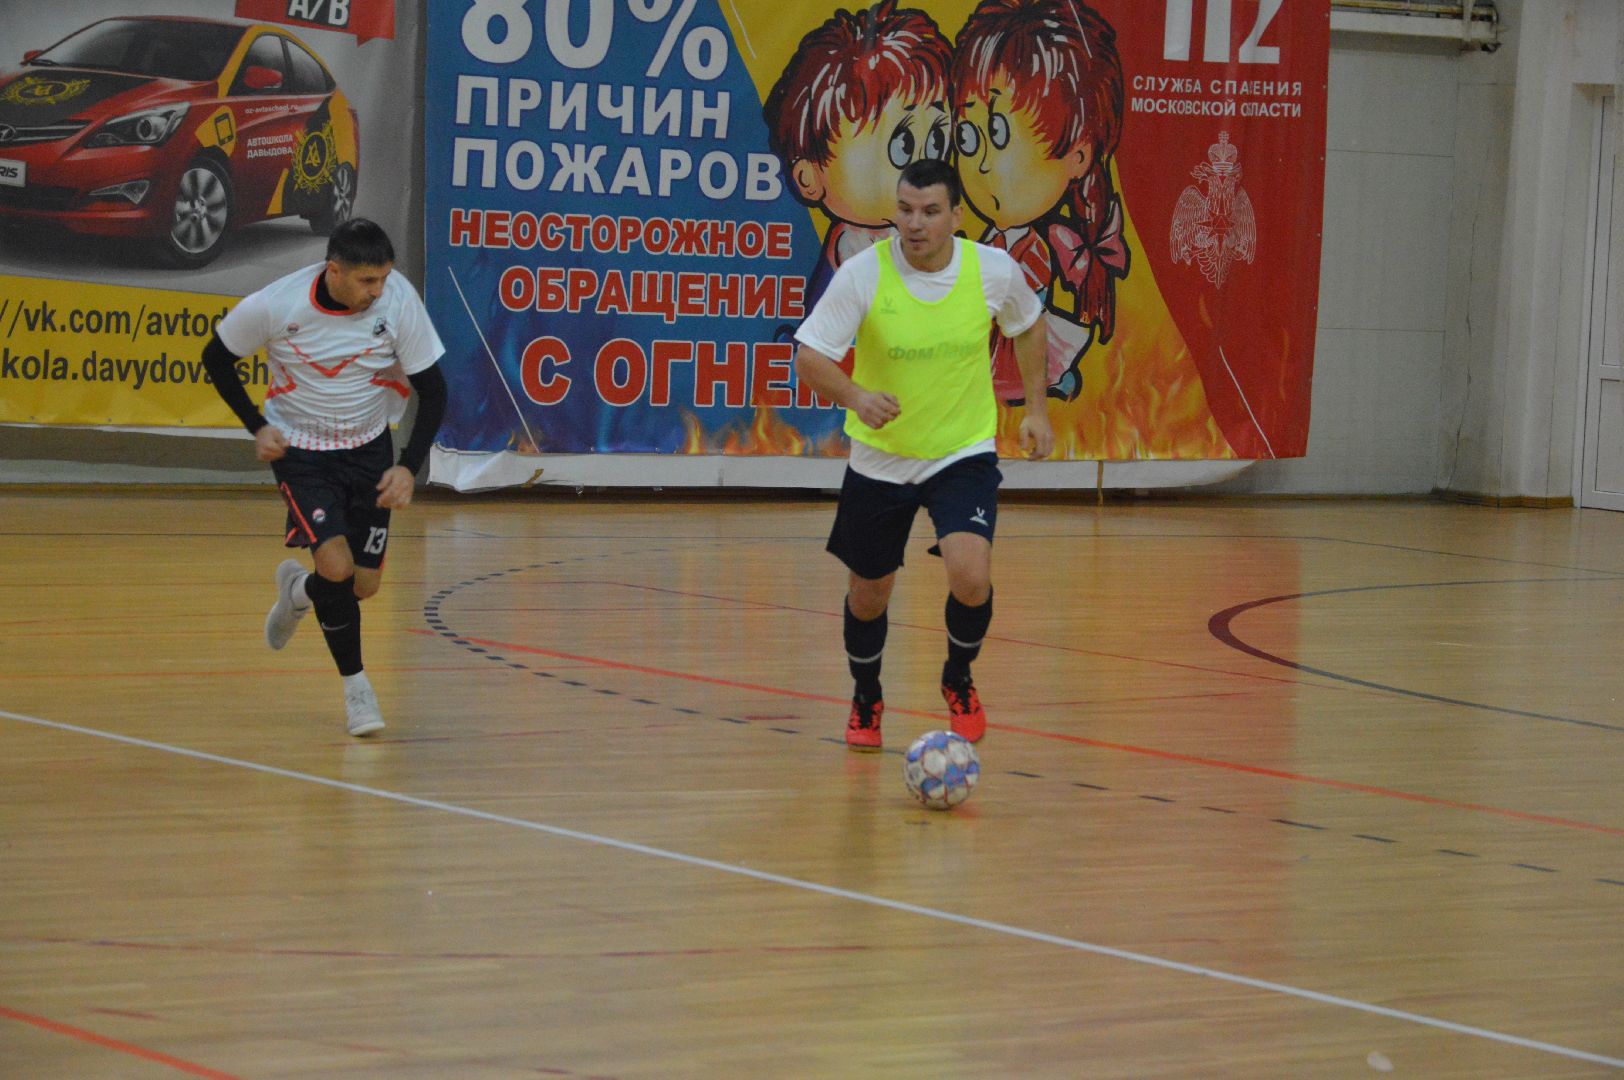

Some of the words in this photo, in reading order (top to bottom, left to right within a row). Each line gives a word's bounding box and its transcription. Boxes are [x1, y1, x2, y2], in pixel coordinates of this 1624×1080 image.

[461, 0, 729, 80] 80%
[455, 74, 731, 139] ПРИЧИН
[1131, 97, 1236, 117] МОСКОВСКОЙ
[1132, 75, 1202, 93] СЛУЖБА
[1210, 80, 1302, 96] СПАЕНИЯ
[247, 134, 293, 147] АВТОШКОЛА
[247, 146, 293, 159] ДАВЫДОВА
[451, 137, 784, 201] ПОЖАРОВ
[449, 208, 793, 258] НЕОСТОРОЖНОЕ
[499, 265, 807, 324] ОБРАЩЕНИЕ
[520, 335, 571, 407] С
[363, 526, 387, 555] 13
